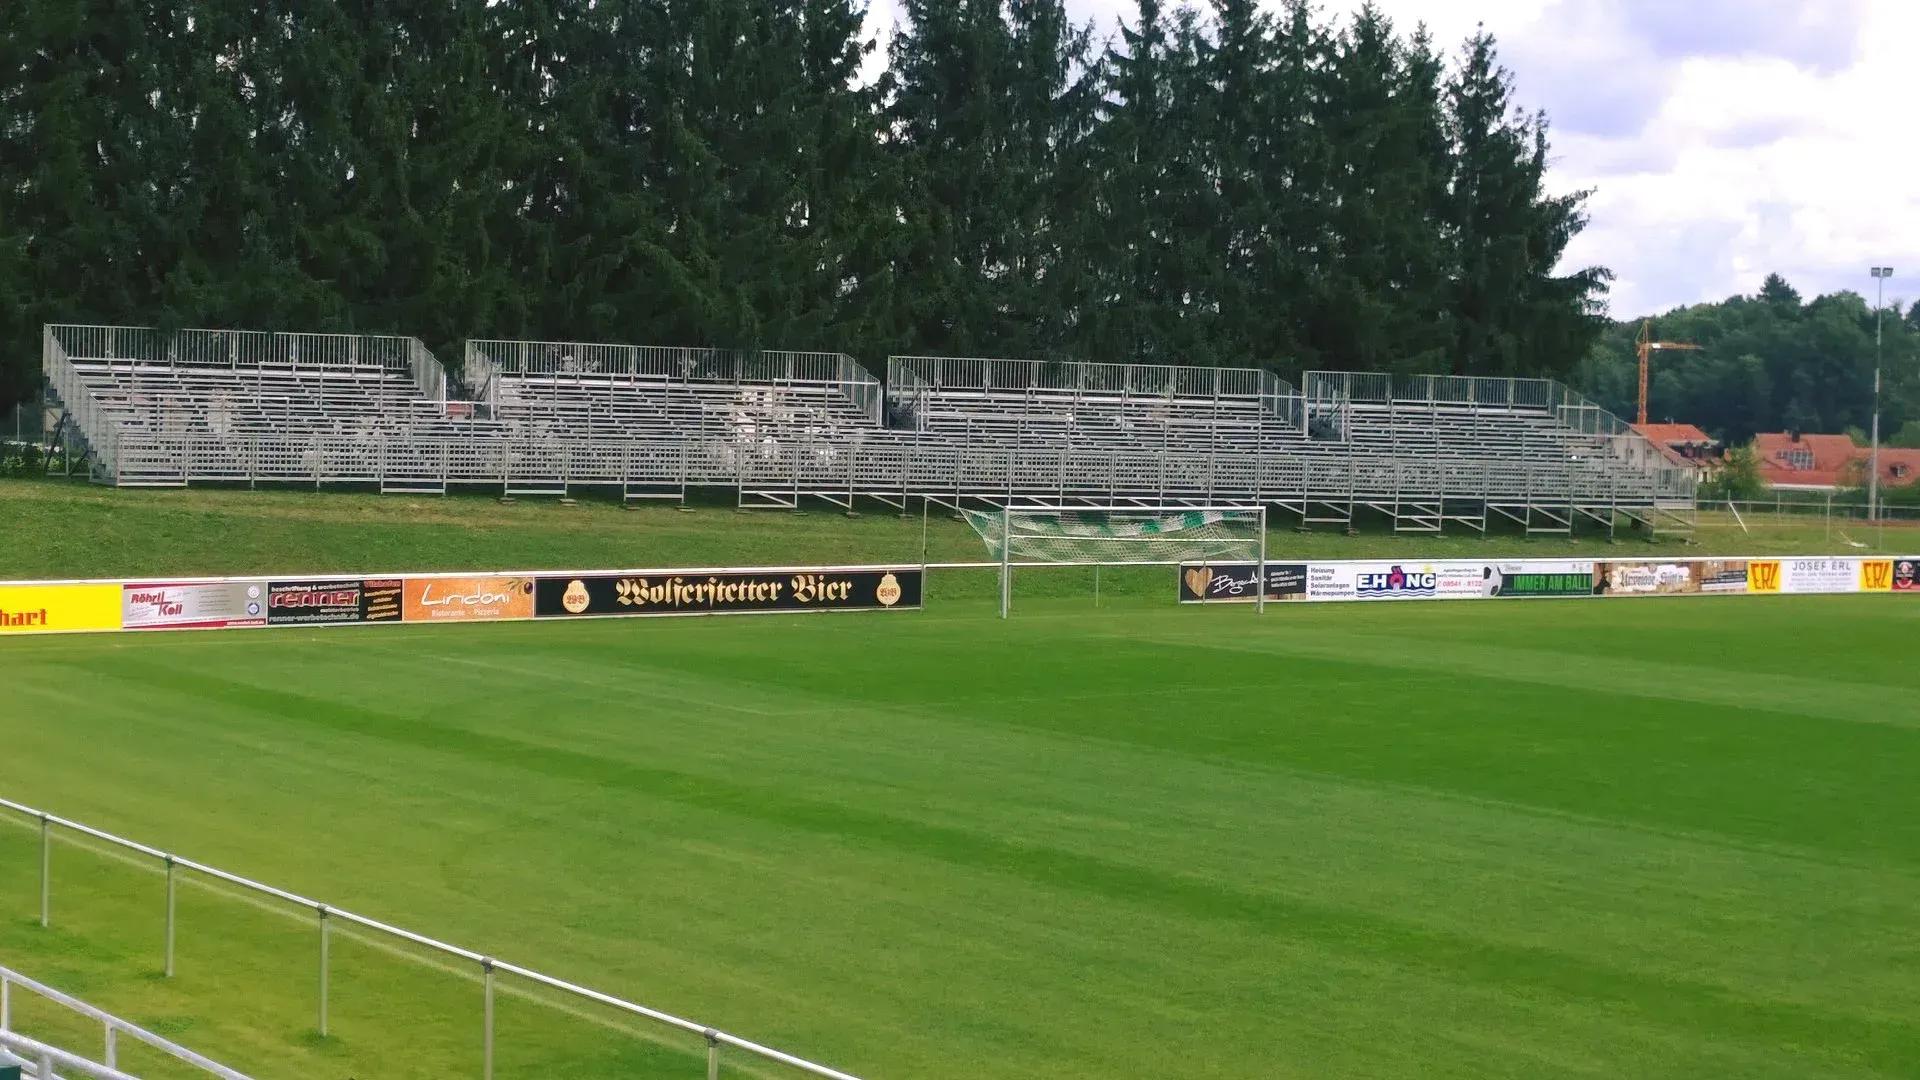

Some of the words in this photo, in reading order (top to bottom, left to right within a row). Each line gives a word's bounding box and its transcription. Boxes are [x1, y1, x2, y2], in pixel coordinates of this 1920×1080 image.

[1792, 561, 1826, 571] JOSEF
[1831, 561, 1852, 571] ERL
[1513, 575, 1545, 590] IMMER
[1548, 575, 1563, 590] AM
[1750, 562, 1779, 589] ERL
[1862, 562, 1890, 588] ERL
[318, 582, 359, 590] werbetechnik
[791, 574, 853, 602] Bier
[131, 591, 162, 604] Röhrl
[269, 588, 360, 608] renner
[421, 583, 510, 606] Liridoni
[269, 613, 360, 622] renner-werbetechnik.de
[431, 609, 465, 617] Ristorante
[473, 608, 500, 616] Pizzeria
